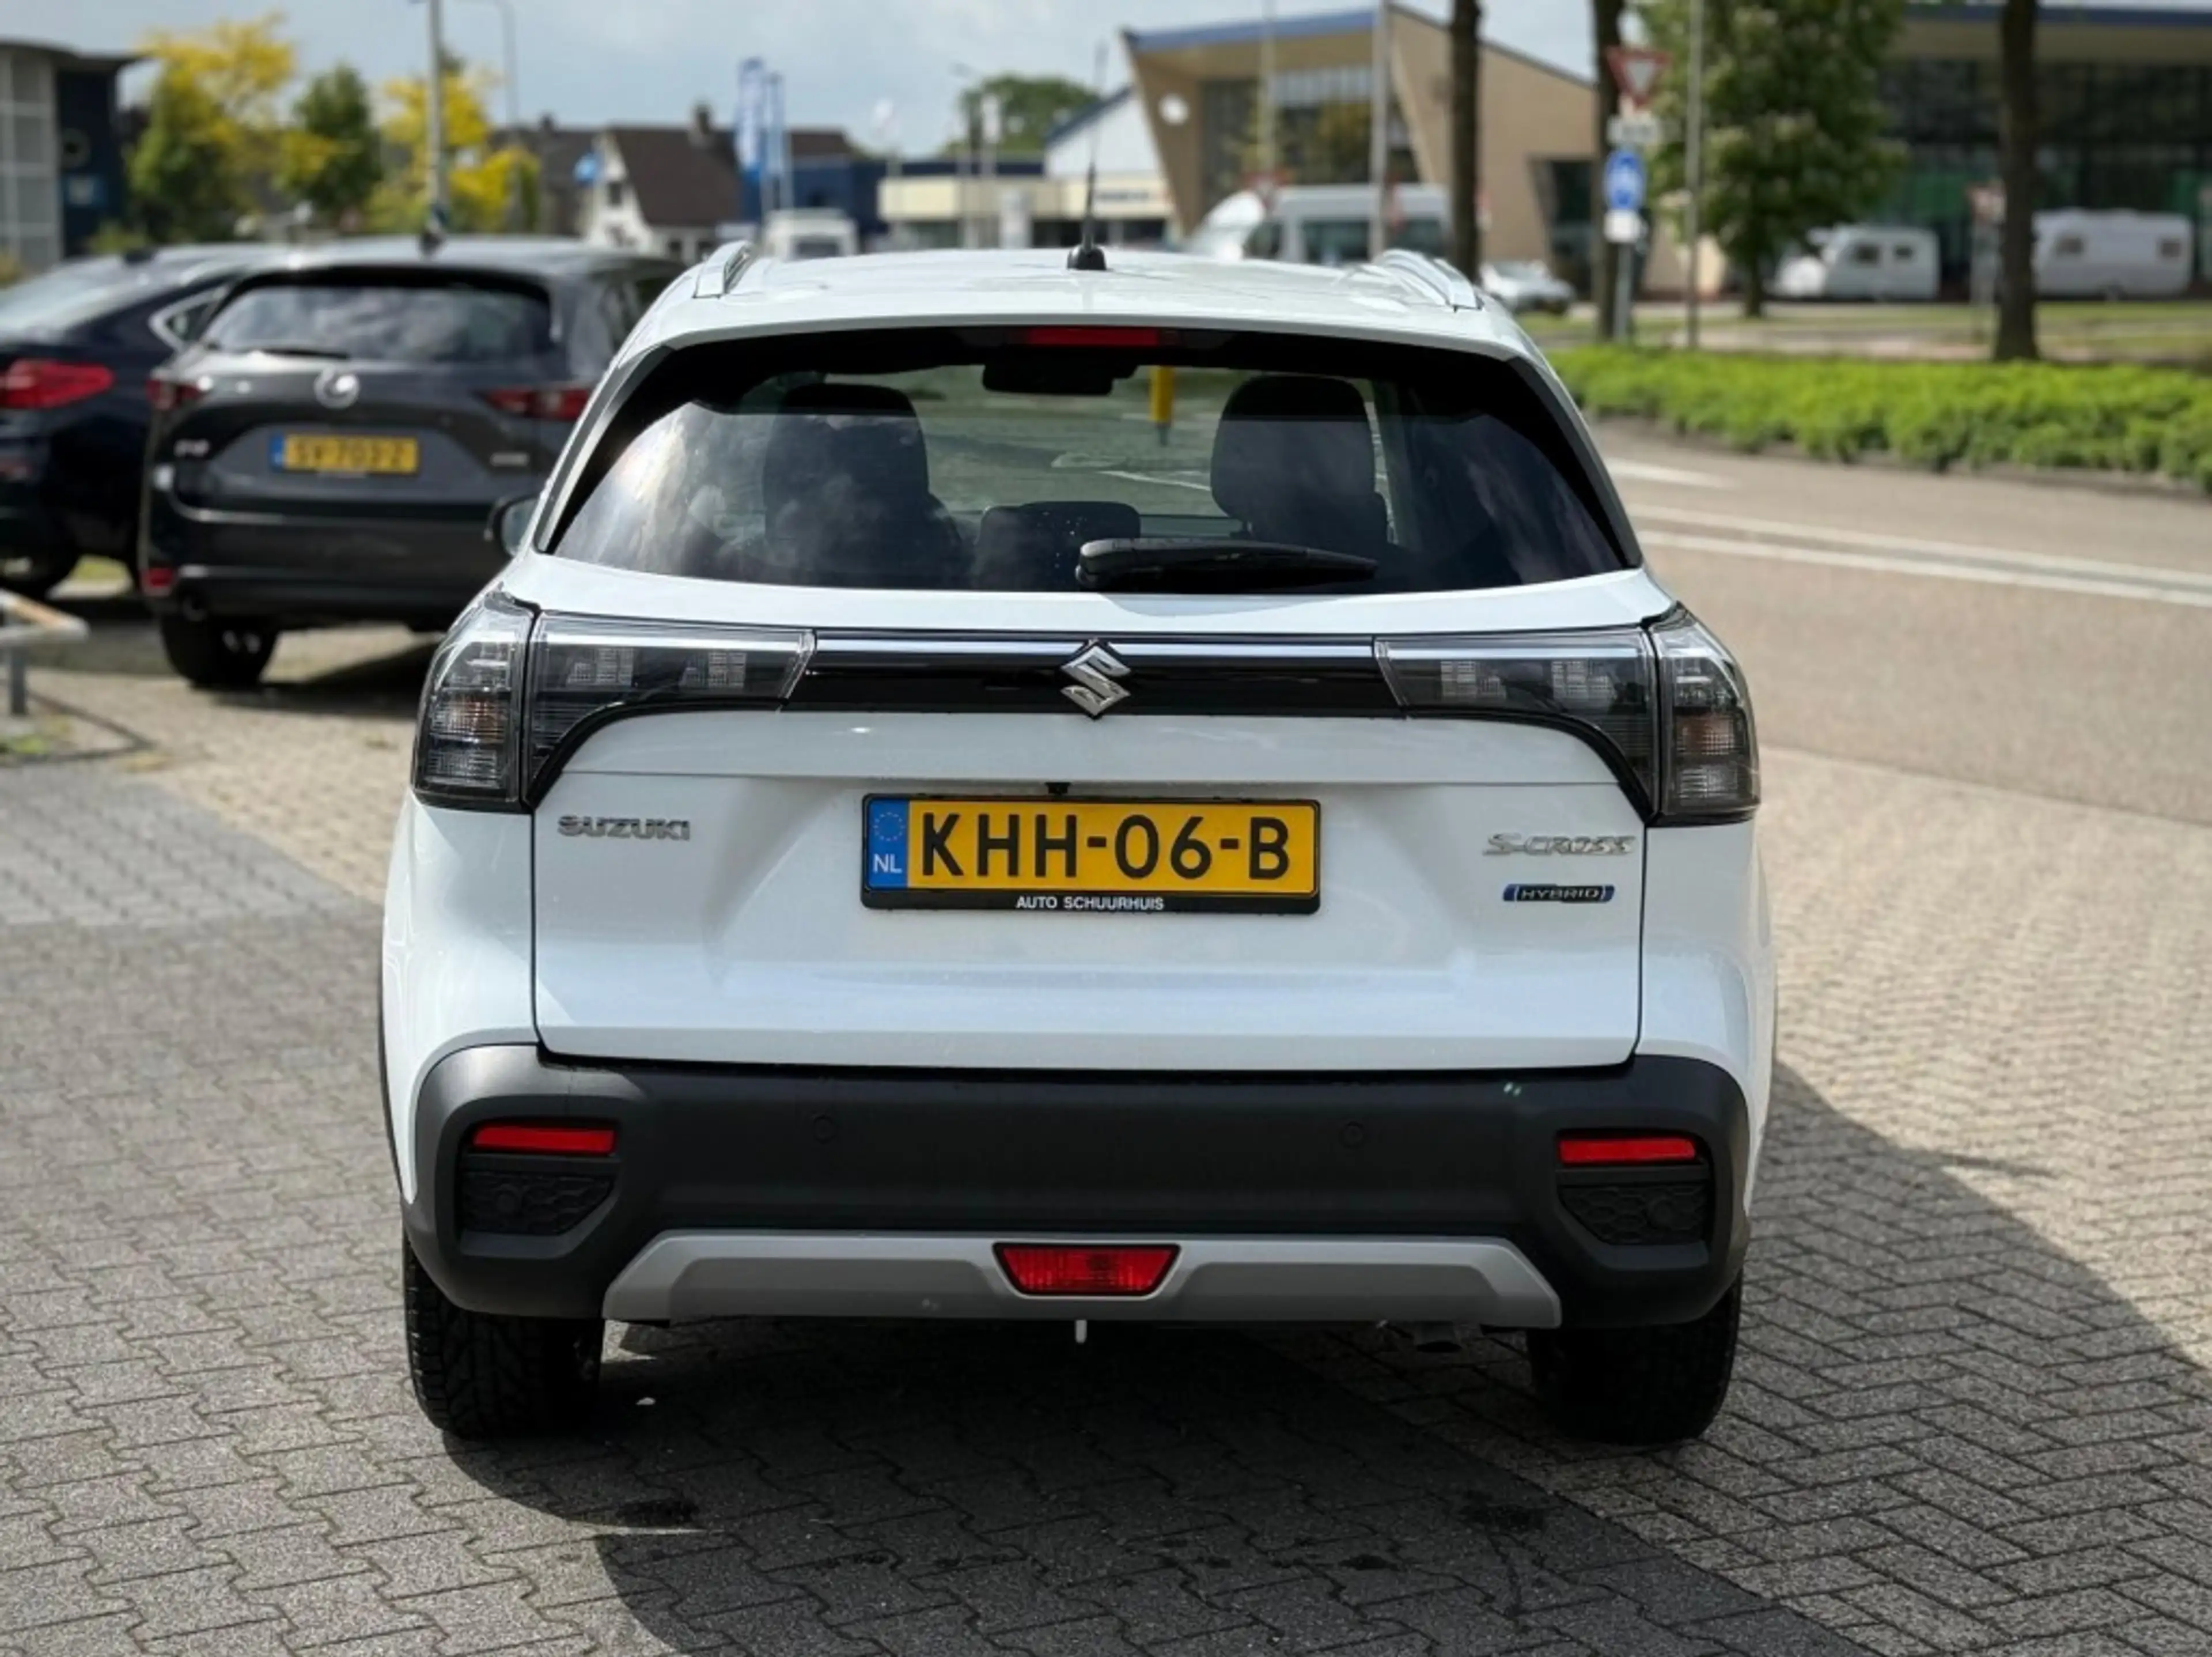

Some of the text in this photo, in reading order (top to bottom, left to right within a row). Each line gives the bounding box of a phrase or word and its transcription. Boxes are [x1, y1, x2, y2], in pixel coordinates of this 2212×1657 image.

[558, 815, 690, 841] SUZUKI
[923, 812, 1290, 879] KHH-06-B
[1482, 833, 1637, 856] S-CROSS
[872, 853, 903, 873] NL
[1016, 895, 1165, 910] AUTO SCHUURHUIS
[1520, 888, 1600, 901] HYBRID
